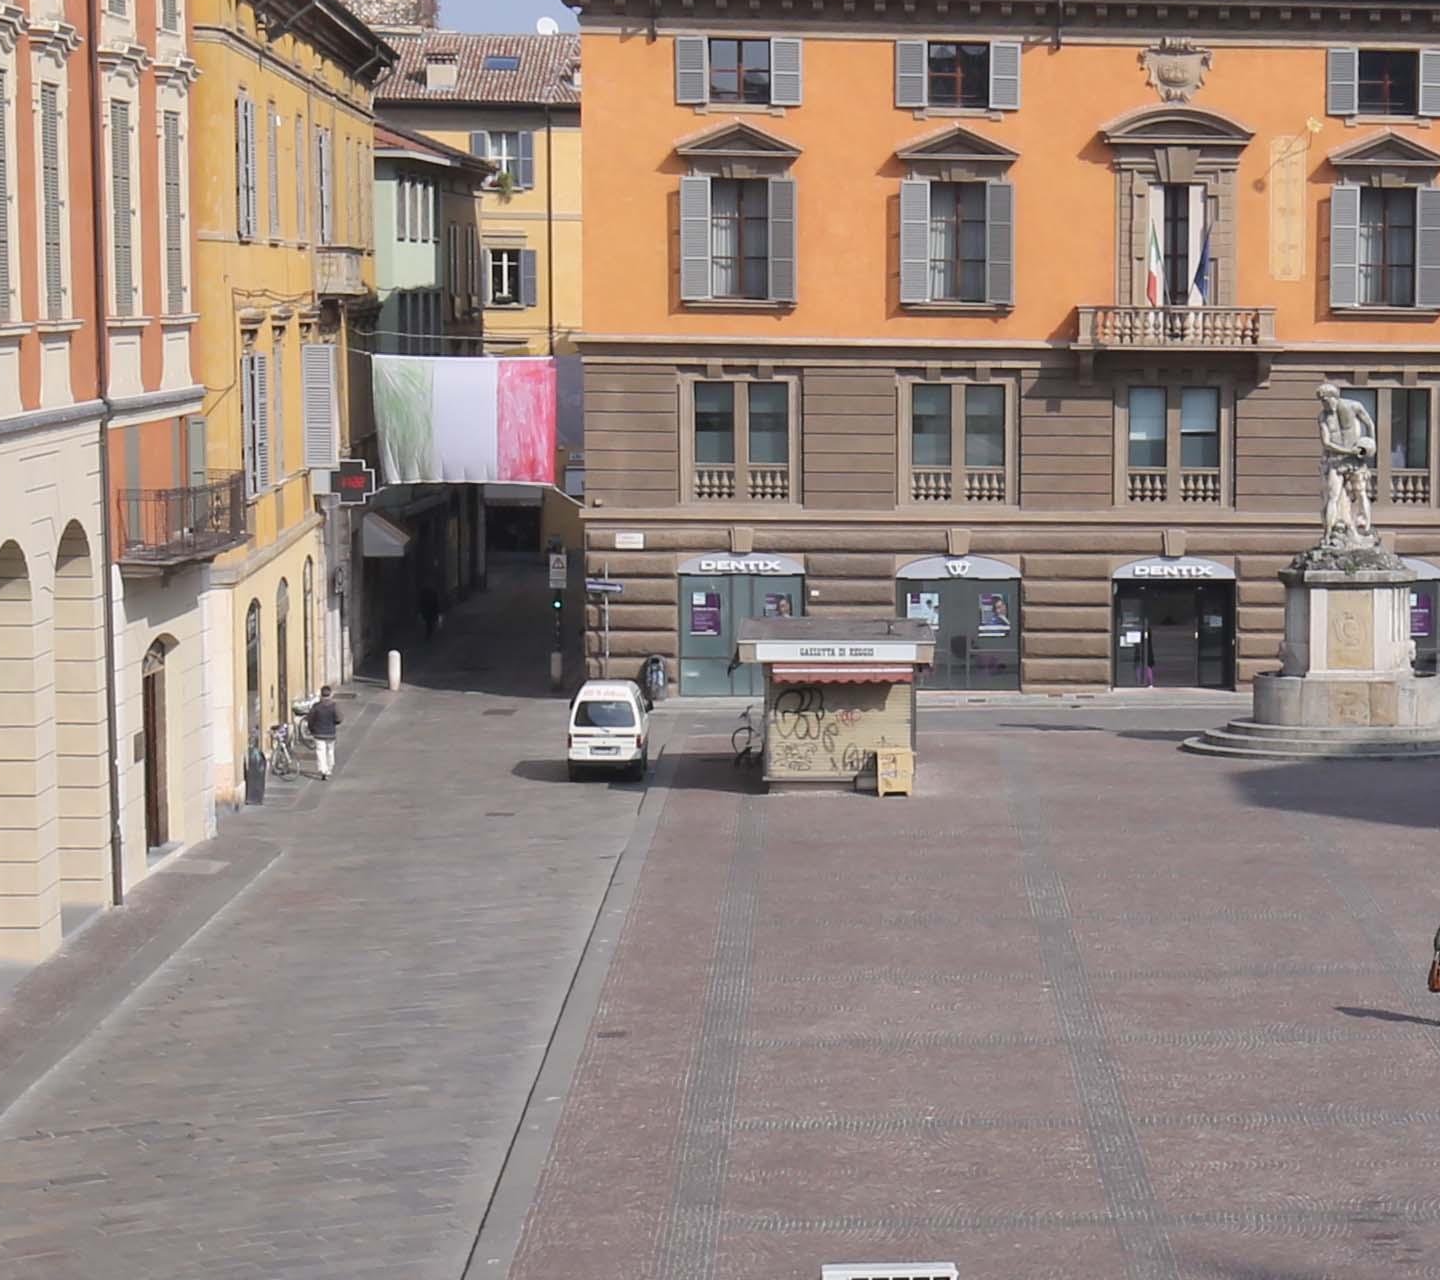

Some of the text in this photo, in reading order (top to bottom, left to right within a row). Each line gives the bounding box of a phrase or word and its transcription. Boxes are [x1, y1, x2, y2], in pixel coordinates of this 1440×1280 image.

[700, 560, 781, 570] DENTIX
[1134, 566, 1213, 575] DENTIX
[839, 648, 846, 656] DI
